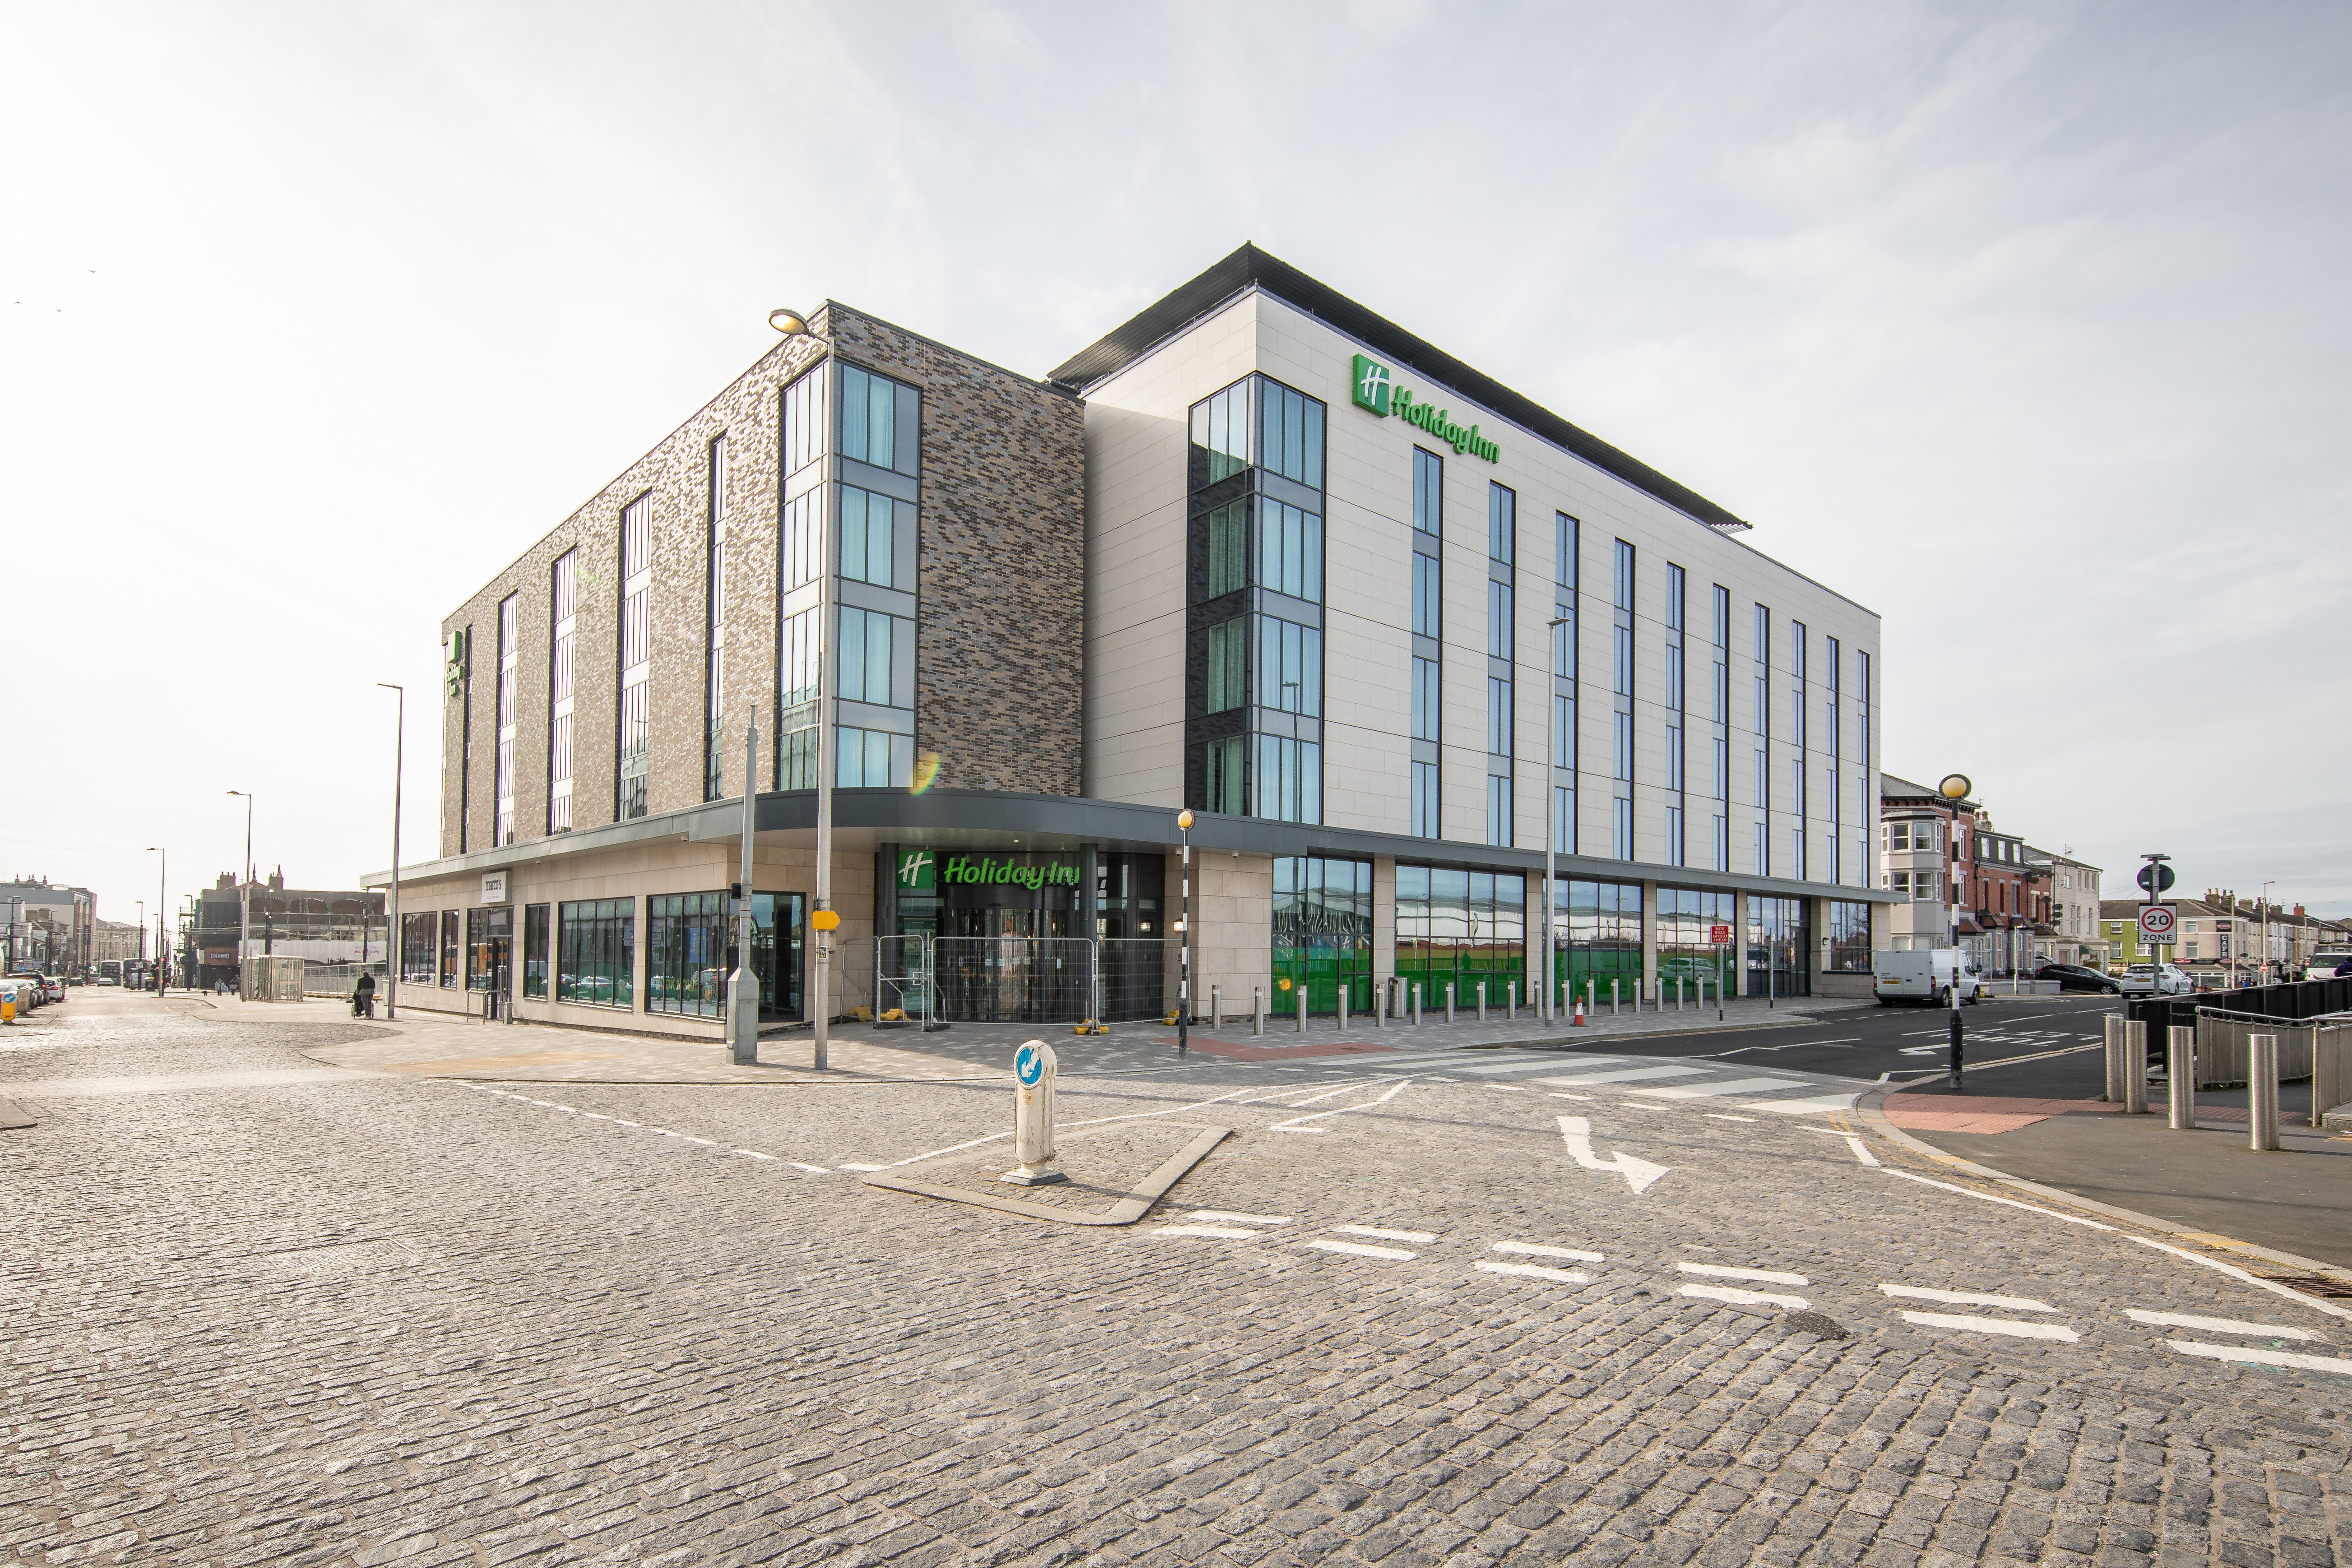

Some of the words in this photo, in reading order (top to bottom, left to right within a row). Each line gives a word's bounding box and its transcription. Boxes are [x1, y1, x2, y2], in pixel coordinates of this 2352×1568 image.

[1391, 385, 1470, 455] Holiday
[1469, 424, 1500, 464] Inn
[944, 857, 1045, 890] Holiday
[485, 875, 502, 892] marco's
[2147, 915, 2169, 925] 20
[1968, 1028, 2103, 1040] LEFT
